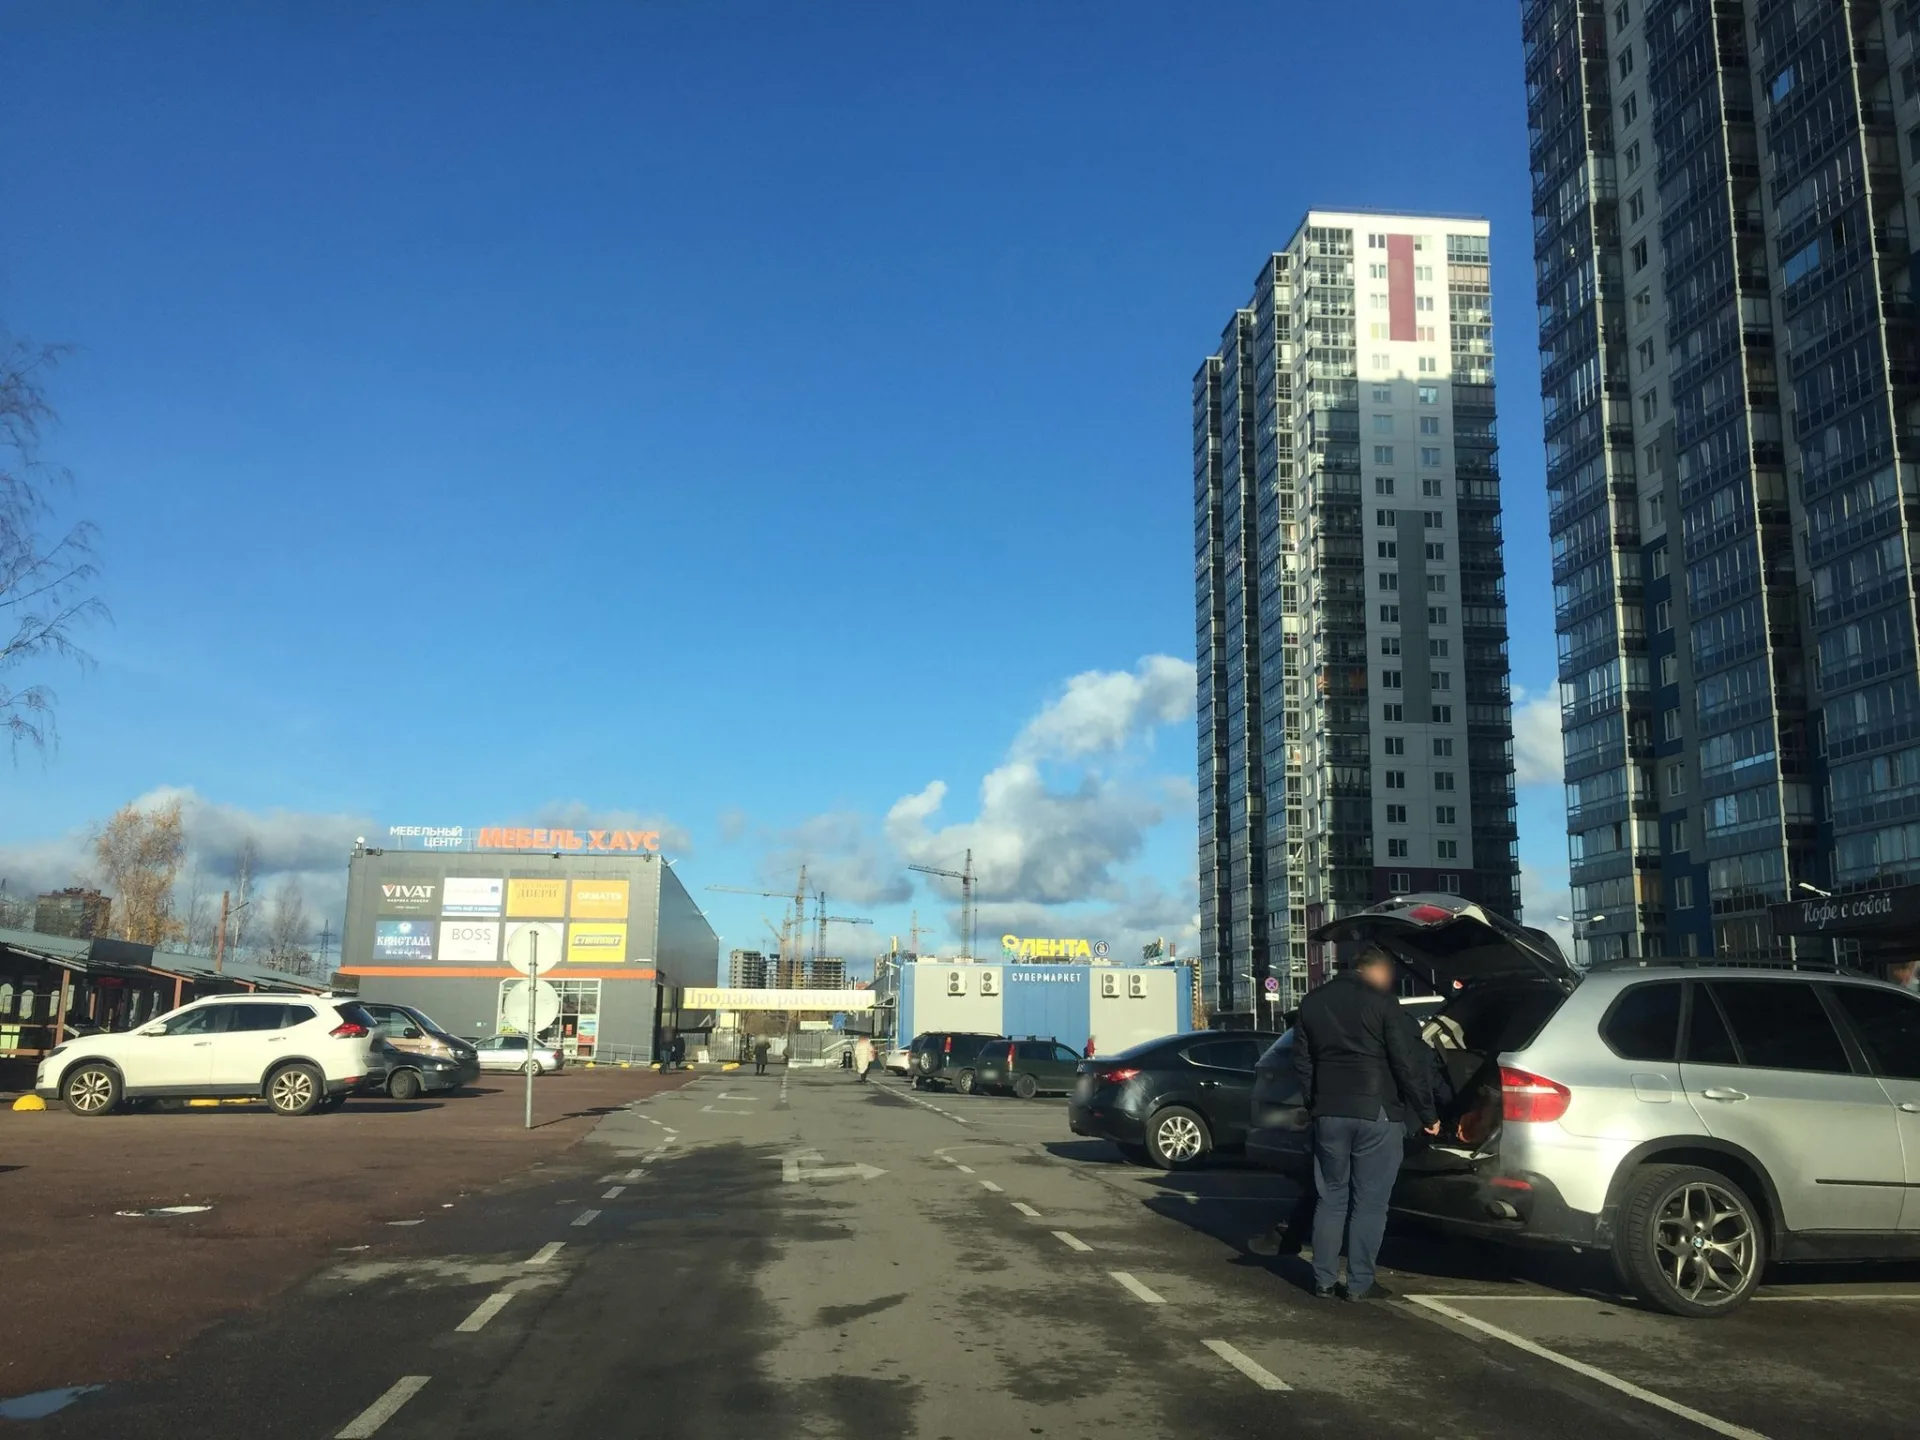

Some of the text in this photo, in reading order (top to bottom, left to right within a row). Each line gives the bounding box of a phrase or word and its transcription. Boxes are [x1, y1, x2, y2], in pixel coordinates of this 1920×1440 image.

[390, 826, 463, 837] МЕБЕЛЬНЫЙ
[424, 837, 463, 848] ЦЕНТР
[478, 828, 660, 851] МЕБЕЛЬ ХАУС
[381, 884, 436, 898] VIVAT
[1802, 892, 1892, 930] Кофе с собой
[377, 935, 431, 946] КРИСТАЛЛ
[452, 928, 491, 941] BOSS
[1018, 938, 1092, 957] ЛЕНТА
[1012, 973, 1081, 983] СУПЕРМАРКЕТ
[683, 989, 770, 1008] Продажа
